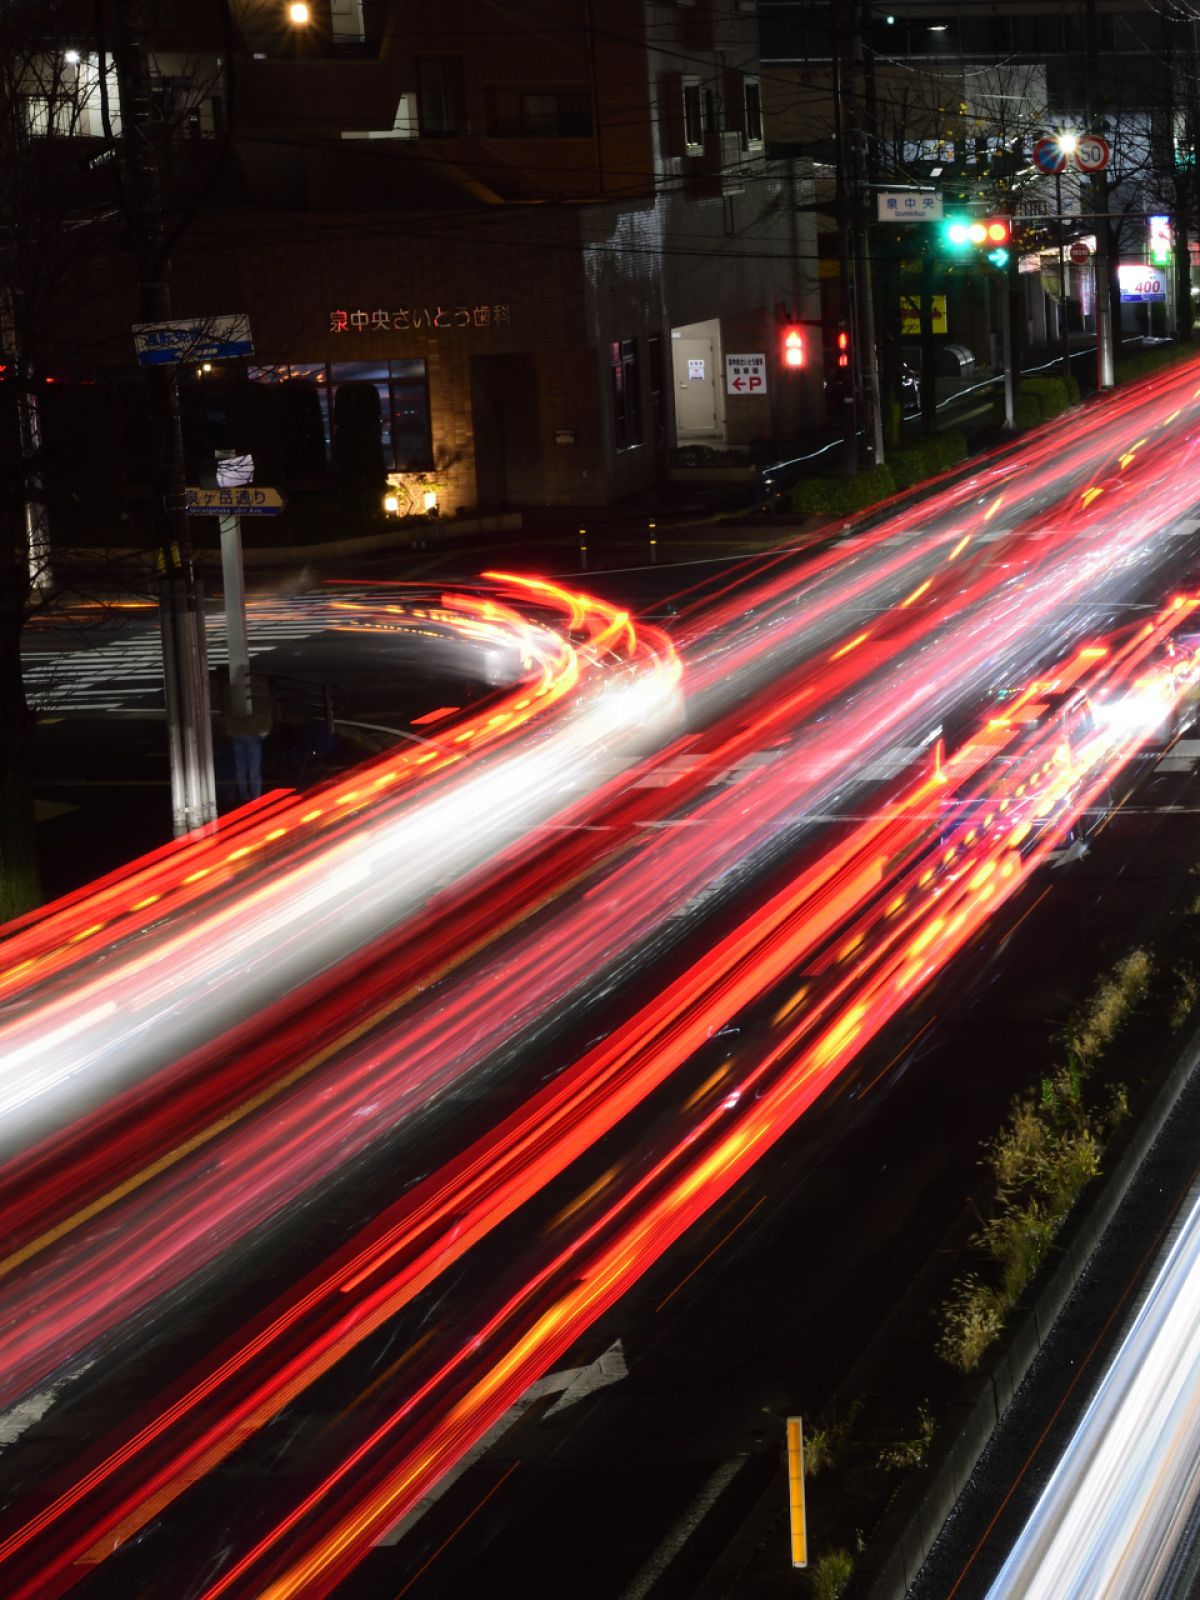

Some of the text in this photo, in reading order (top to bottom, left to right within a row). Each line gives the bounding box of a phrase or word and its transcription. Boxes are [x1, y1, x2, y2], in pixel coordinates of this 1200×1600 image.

[1080, 145, 1101, 163] 50
[886, 197, 935, 209] 泉中央
[1135, 280, 1161, 293] 400
[329, 304, 511, 333] 泉中央さいとう歯科
[749, 376, 762, 391] P
